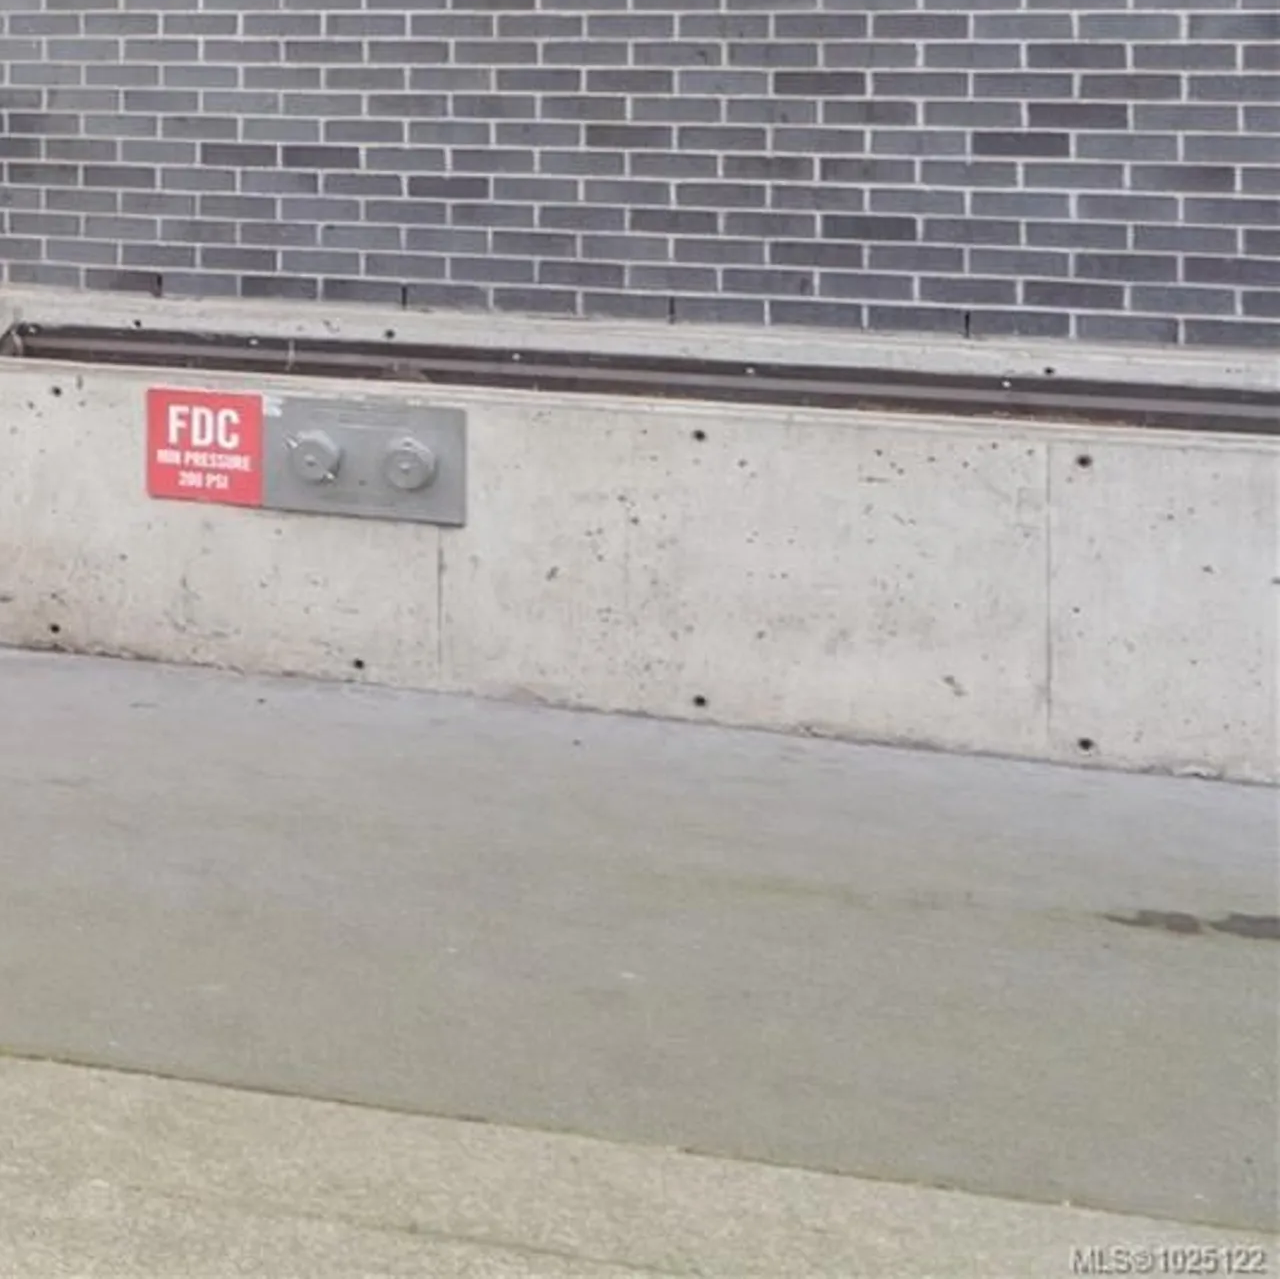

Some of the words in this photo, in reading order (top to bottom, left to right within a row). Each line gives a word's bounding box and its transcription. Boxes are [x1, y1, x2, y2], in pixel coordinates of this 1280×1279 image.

[168, 405, 240, 449] FDC
[184, 451, 252, 472] PRESSURE
[205, 472, 228, 489] PSI
